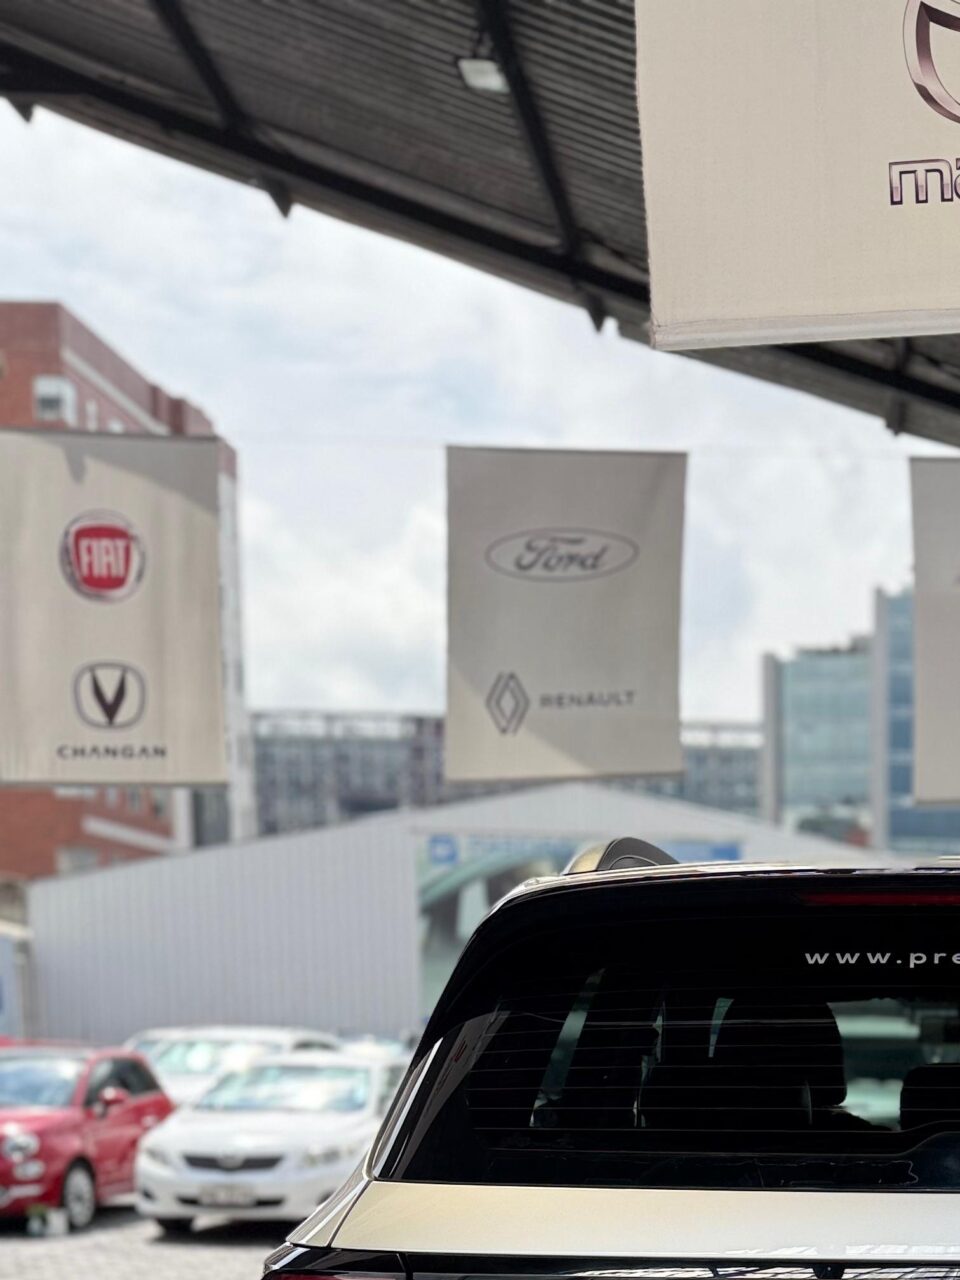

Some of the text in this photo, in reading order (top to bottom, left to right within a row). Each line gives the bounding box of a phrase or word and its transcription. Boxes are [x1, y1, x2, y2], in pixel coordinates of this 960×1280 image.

[79, 537, 129, 578] FIAT
[514, 535, 610, 572] Ford
[538, 690, 635, 708] RENAULT
[56, 744, 168, 760] CHANGAN
